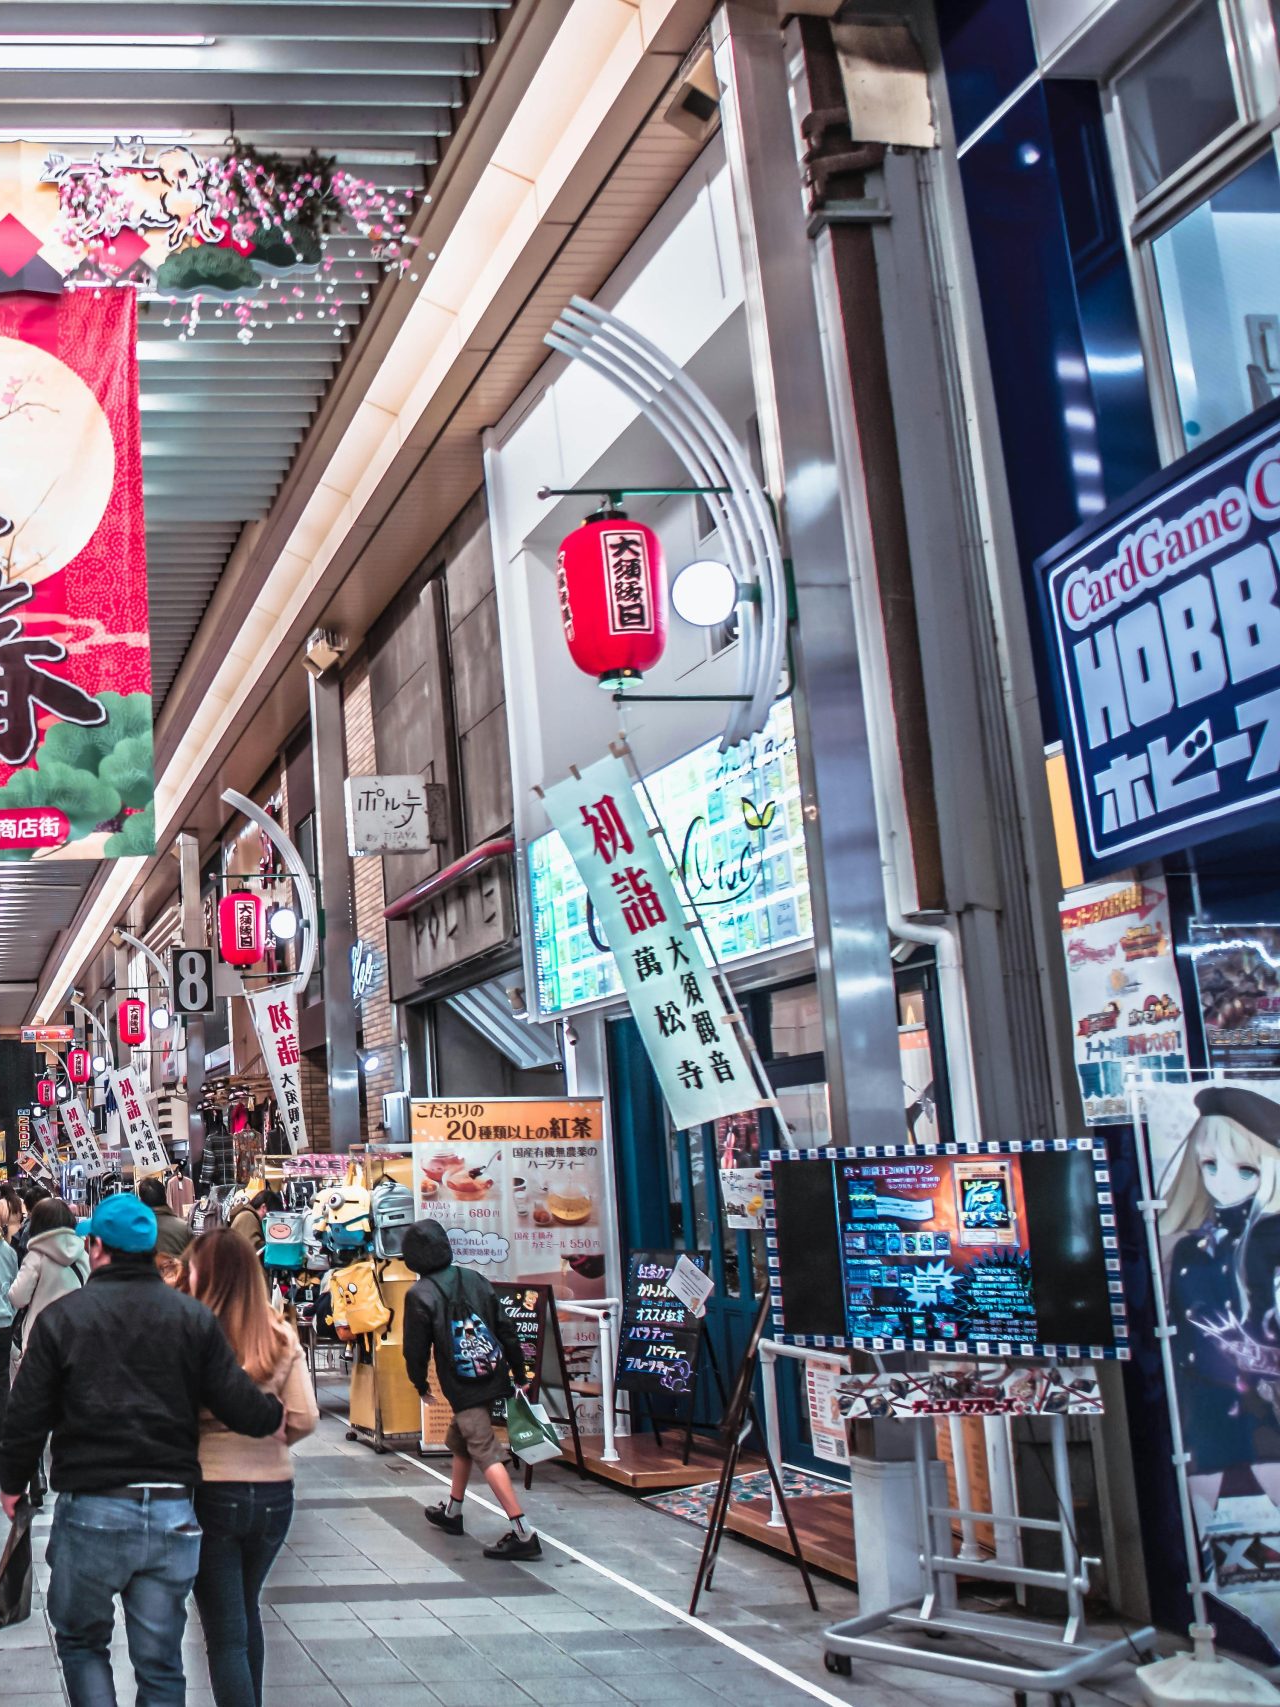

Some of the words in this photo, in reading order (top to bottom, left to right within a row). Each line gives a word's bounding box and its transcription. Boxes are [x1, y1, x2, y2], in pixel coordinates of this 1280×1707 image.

[1067, 497, 1242, 622] CardGame
[1073, 538, 1280, 750] HOBB
[357, 788, 423, 829] ポルテ
[580, 794, 668, 936] 初詣
[179, 951, 209, 1011] 8
[632, 946, 705, 1090] 萬松寺
[664, 936, 737, 1084] 大須観音
[119, 1078, 142, 1121] 初詣
[416, 1103, 484, 1118] こだわりの
[129, 1123, 149, 1166] 萬松寺
[139, 1119, 160, 1163] 大須観音
[446, 1117, 592, 1141] 20種類以上の紅茶
[285, 1159, 341, 1170] SALE
[512, 1147, 597, 1158] 国産有機無農薬の
[527, 1161, 585, 1170] ハーブティー
[531, 1240, 566, 1250] カモミール
[636, 1308, 685, 1323] オススメ紅茶
[911, 1398, 1017, 1415] デュエルマスターズ
